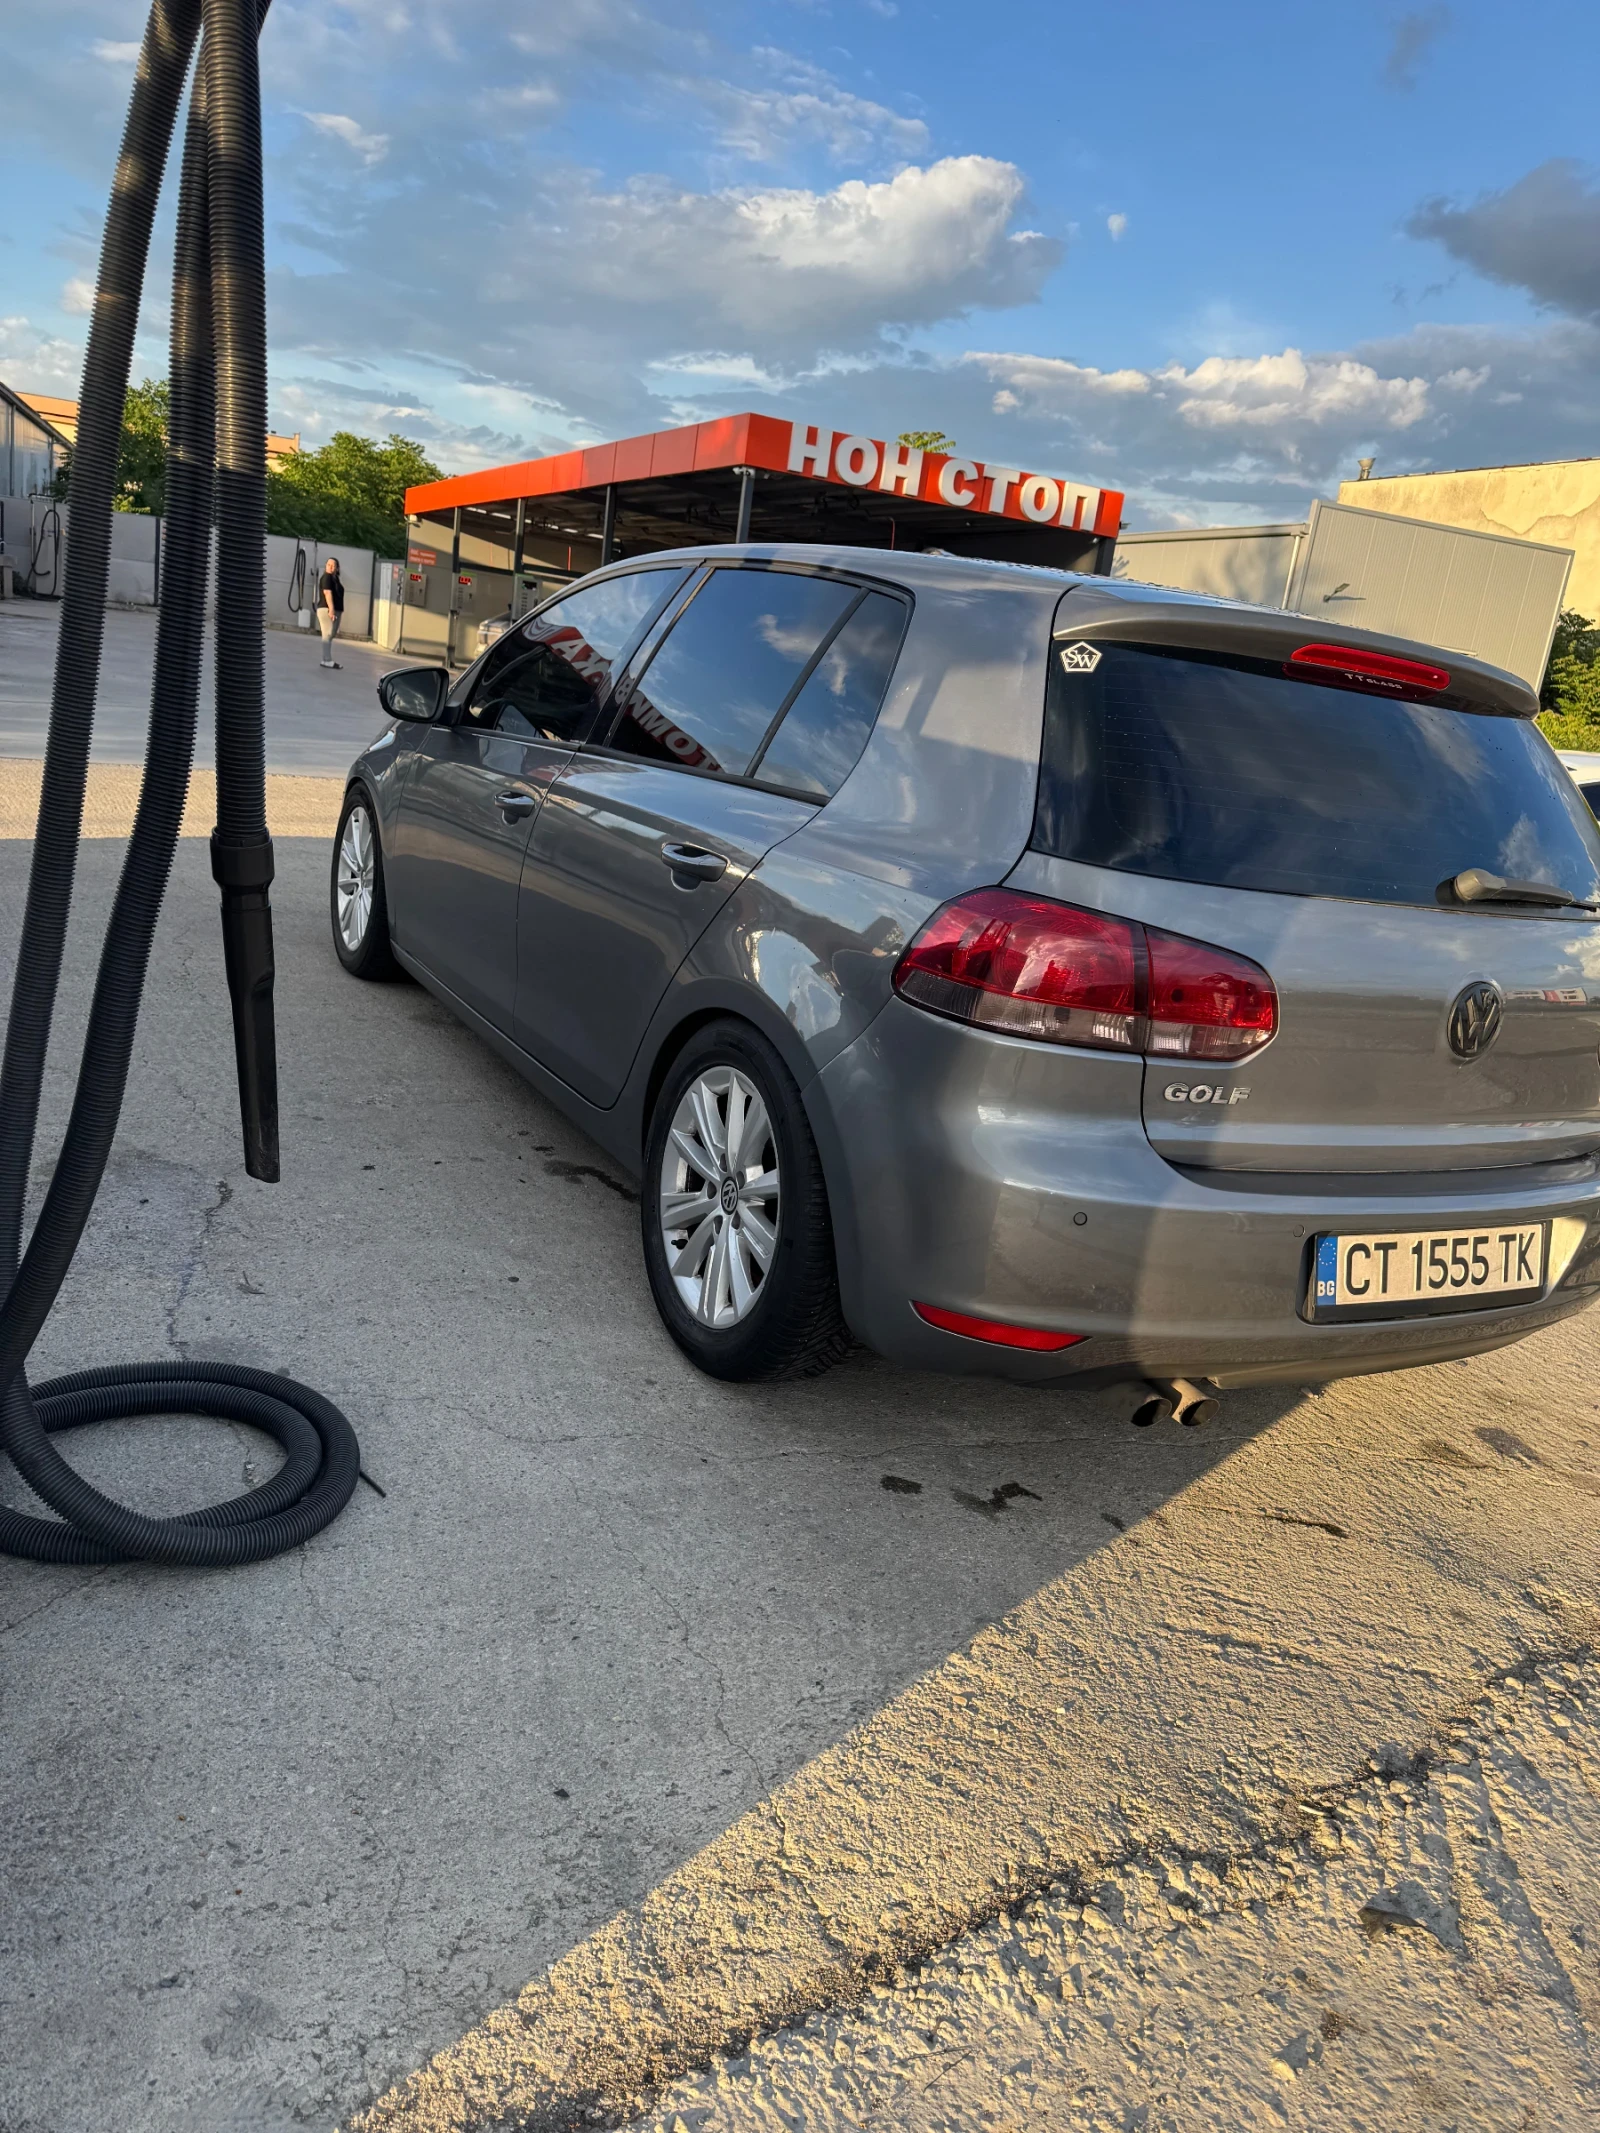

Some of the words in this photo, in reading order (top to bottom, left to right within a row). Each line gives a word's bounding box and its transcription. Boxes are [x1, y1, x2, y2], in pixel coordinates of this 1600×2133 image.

[787, 422, 923, 496] НОН
[939, 458, 1100, 532] СТОП
[1164, 1082, 1252, 1105] GOLF
[1346, 1242, 1398, 1296] CT
[1411, 1236, 1489, 1292] 1555
[1499, 1232, 1536, 1283] TK
[1317, 1281, 1335, 1297] BG
